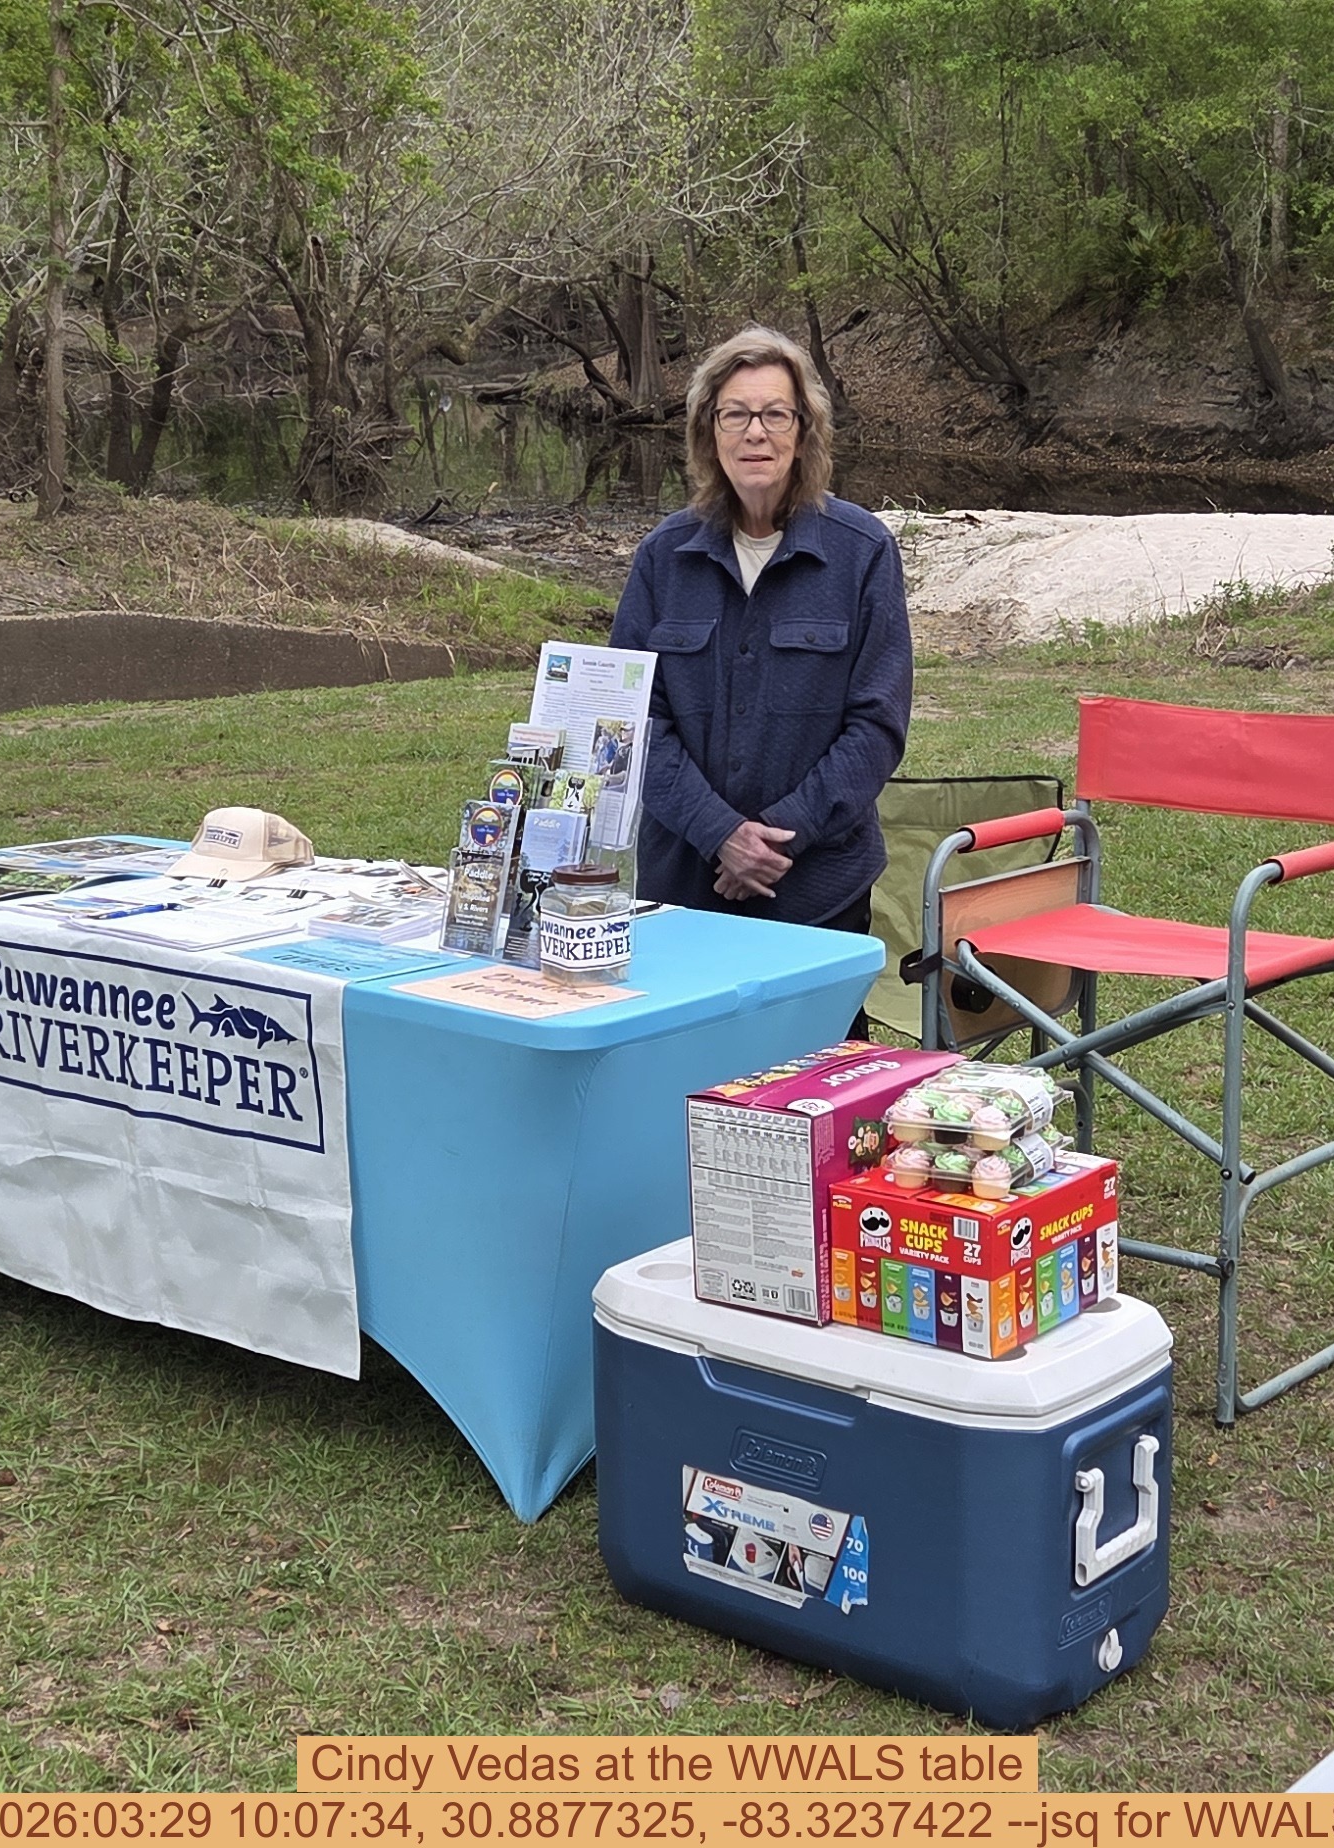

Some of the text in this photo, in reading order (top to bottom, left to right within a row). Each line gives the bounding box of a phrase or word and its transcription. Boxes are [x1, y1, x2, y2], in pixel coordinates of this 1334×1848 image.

[899, 1218, 949, 1240] SNACK
[1039, 1214, 1071, 1241] SNACK
[1070, 1203, 1094, 1224] CUPS
[905, 1234, 943, 1254] CUPS
[963, 1242, 982, 1257] 27
[898, 1246, 950, 1264] VARIETY PACK
[962, 1255, 982, 1266] CUPS
[704, 1477, 735, 1496] Coleman
[701, 1495, 776, 1533] XTREME
[846, 1536, 864, 1553] 70
[842, 1565, 867, 1583] 100
